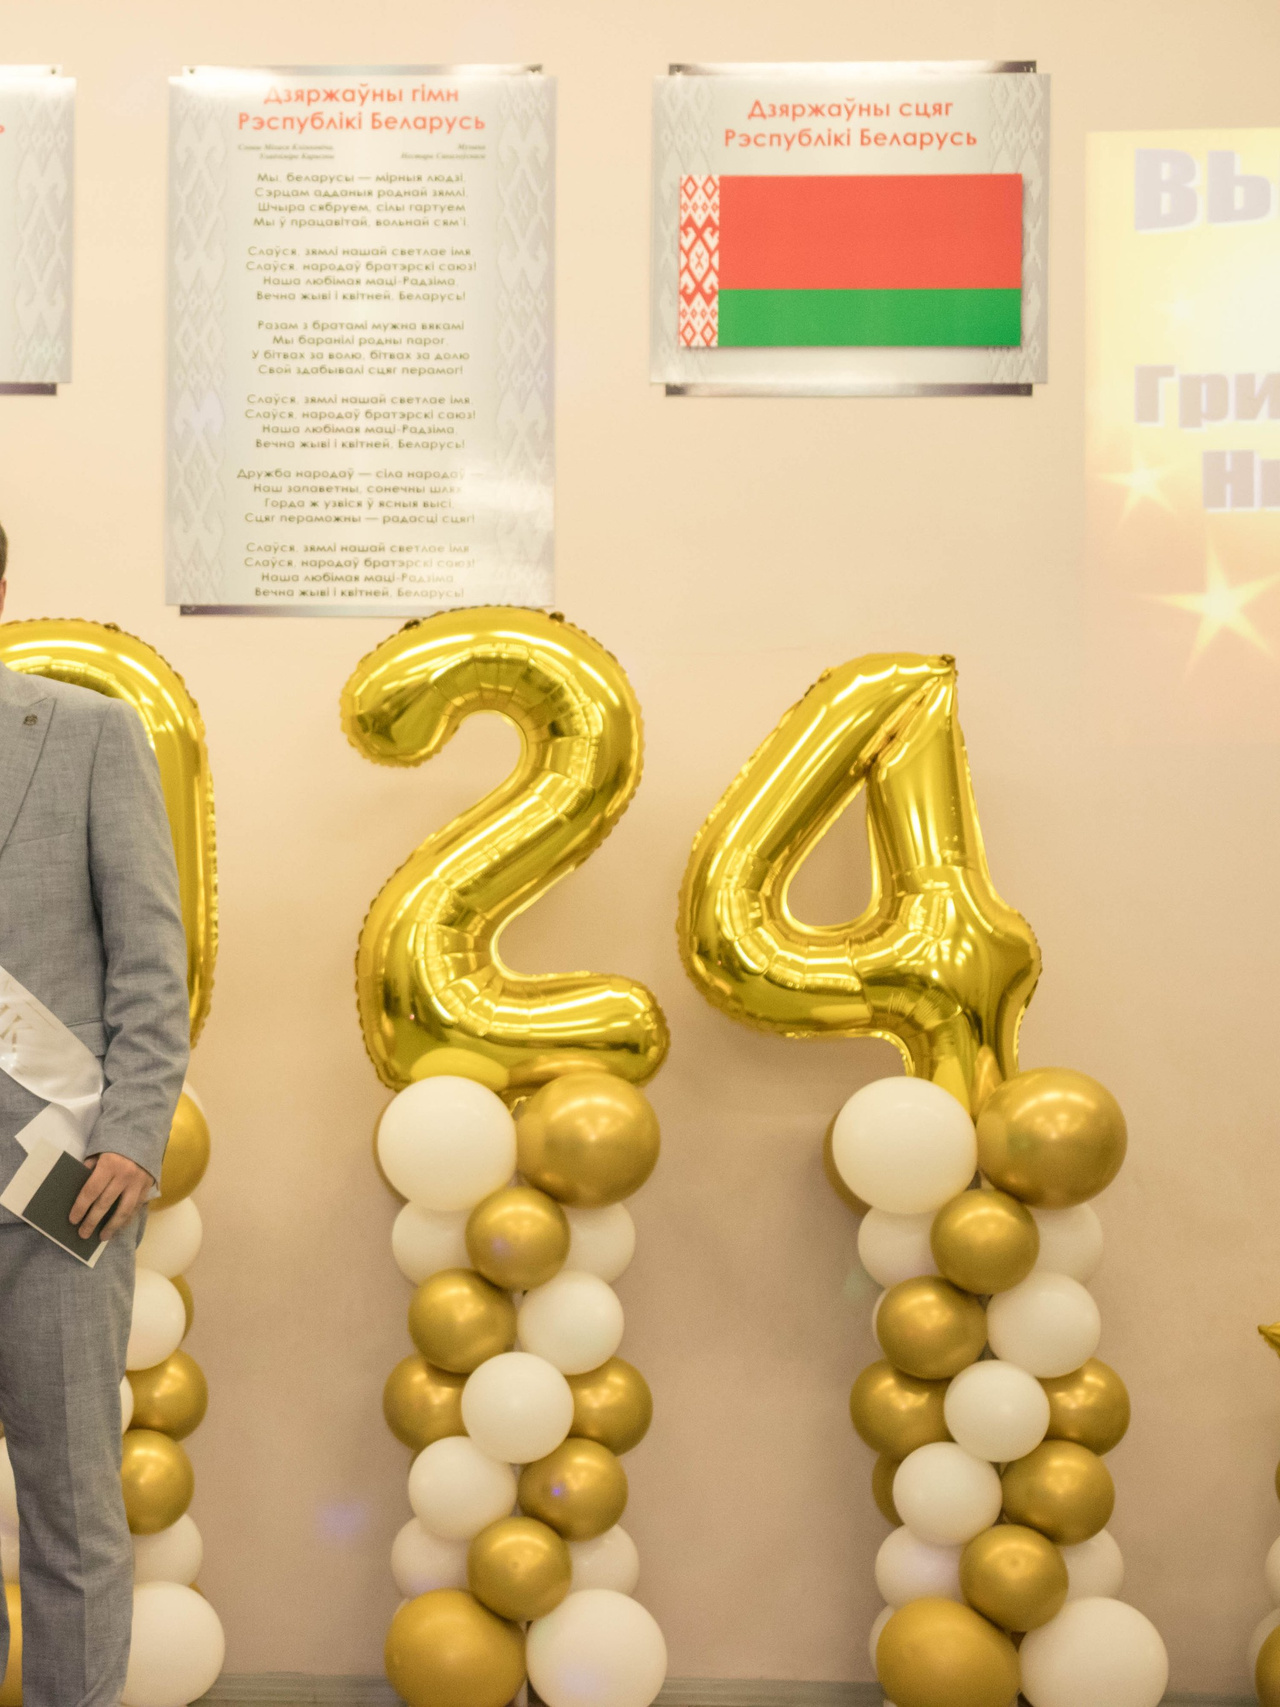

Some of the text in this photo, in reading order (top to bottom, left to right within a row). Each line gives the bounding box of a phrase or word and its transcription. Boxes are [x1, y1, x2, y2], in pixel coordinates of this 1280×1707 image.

[263, 83, 459, 106] Дзяржаўны гімн
[747, 97, 954, 122] Дзяржаўны сцяг
[237, 112, 486, 134] Рэспублікі Беларусь
[723, 126, 978, 151] Рэспублікі Беларусь
[286, 172, 355, 184] беларусы
[374, 172, 423, 184] мірныя
[254, 187, 310, 200] Сэрцам
[313, 190, 374, 198] адданыя
[376, 187, 428, 200] роднай
[257, 202, 306, 214] Шчыра
[376, 202, 406, 212] сілы
[409, 204, 466, 214] гартуем
[374, 216, 430, 227] вольнай
[304, 246, 339, 256] зямлі
[342, 246, 388, 256] нашай
[390, 248, 447, 256] светлае
[302, 261, 361, 274] народаў
[365, 261, 435, 274] братэрскі
[438, 261, 477, 272] саюз!
[262, 276, 302, 286] Наша
[305, 276, 362, 286] любімая
[256, 290, 296, 301] Вечна
[300, 290, 332, 301] жыві
[398, 290, 466, 303] Беларусь!
[256, 320, 299, 330] Разам
[311, 320, 368, 332] братамі
[370, 322, 417, 332] мужна
[420, 320, 465, 330] вякамі
[297, 334, 355, 347] баранілі
[358, 337, 403, 347] родны
[262, 350, 306, 360] бітвах
[369, 350, 412, 360] бітвах
[434, 352, 471, 361] долю
[256, 364, 464, 376] Свой здабывалі сцяг перамог!
[304, 394, 338, 404] зямлі
[340, 394, 387, 404] нашай
[390, 396, 446, 404] светлае
[301, 409, 360, 422] народаў
[364, 409, 434, 422] братэрскі
[437, 409, 476, 420] саюз!
[262, 424, 301, 434] Наша
[304, 424, 361, 434] любімая
[254, 438, 296, 449] Вечна
[299, 438, 331, 449] жыві
[397, 438, 466, 451] Беларусь!
[236, 468, 292, 480] Дружба
[295, 468, 355, 480] народаў
[374, 468, 404, 478] сіла
[252, 483, 283, 494] Наш
[366, 486, 426, 494] сонечны
[264, 498, 306, 510] Горда
[323, 498, 363, 510] узвіся
[378, 500, 419, 508] ясныя
[243, 512, 276, 524] Сцяг
[279, 515, 362, 525] пераможны
[382, 512, 438, 525] радасці
[441, 512, 476, 524] сцяг!
[303, 542, 337, 552] зямлі
[340, 542, 386, 552] нашай
[300, 557, 360, 570] народаў
[260, 572, 300, 582] Наша
[303, 572, 360, 582] любімая
[254, 586, 295, 597] Вечна
[298, 586, 330, 597] жыві
